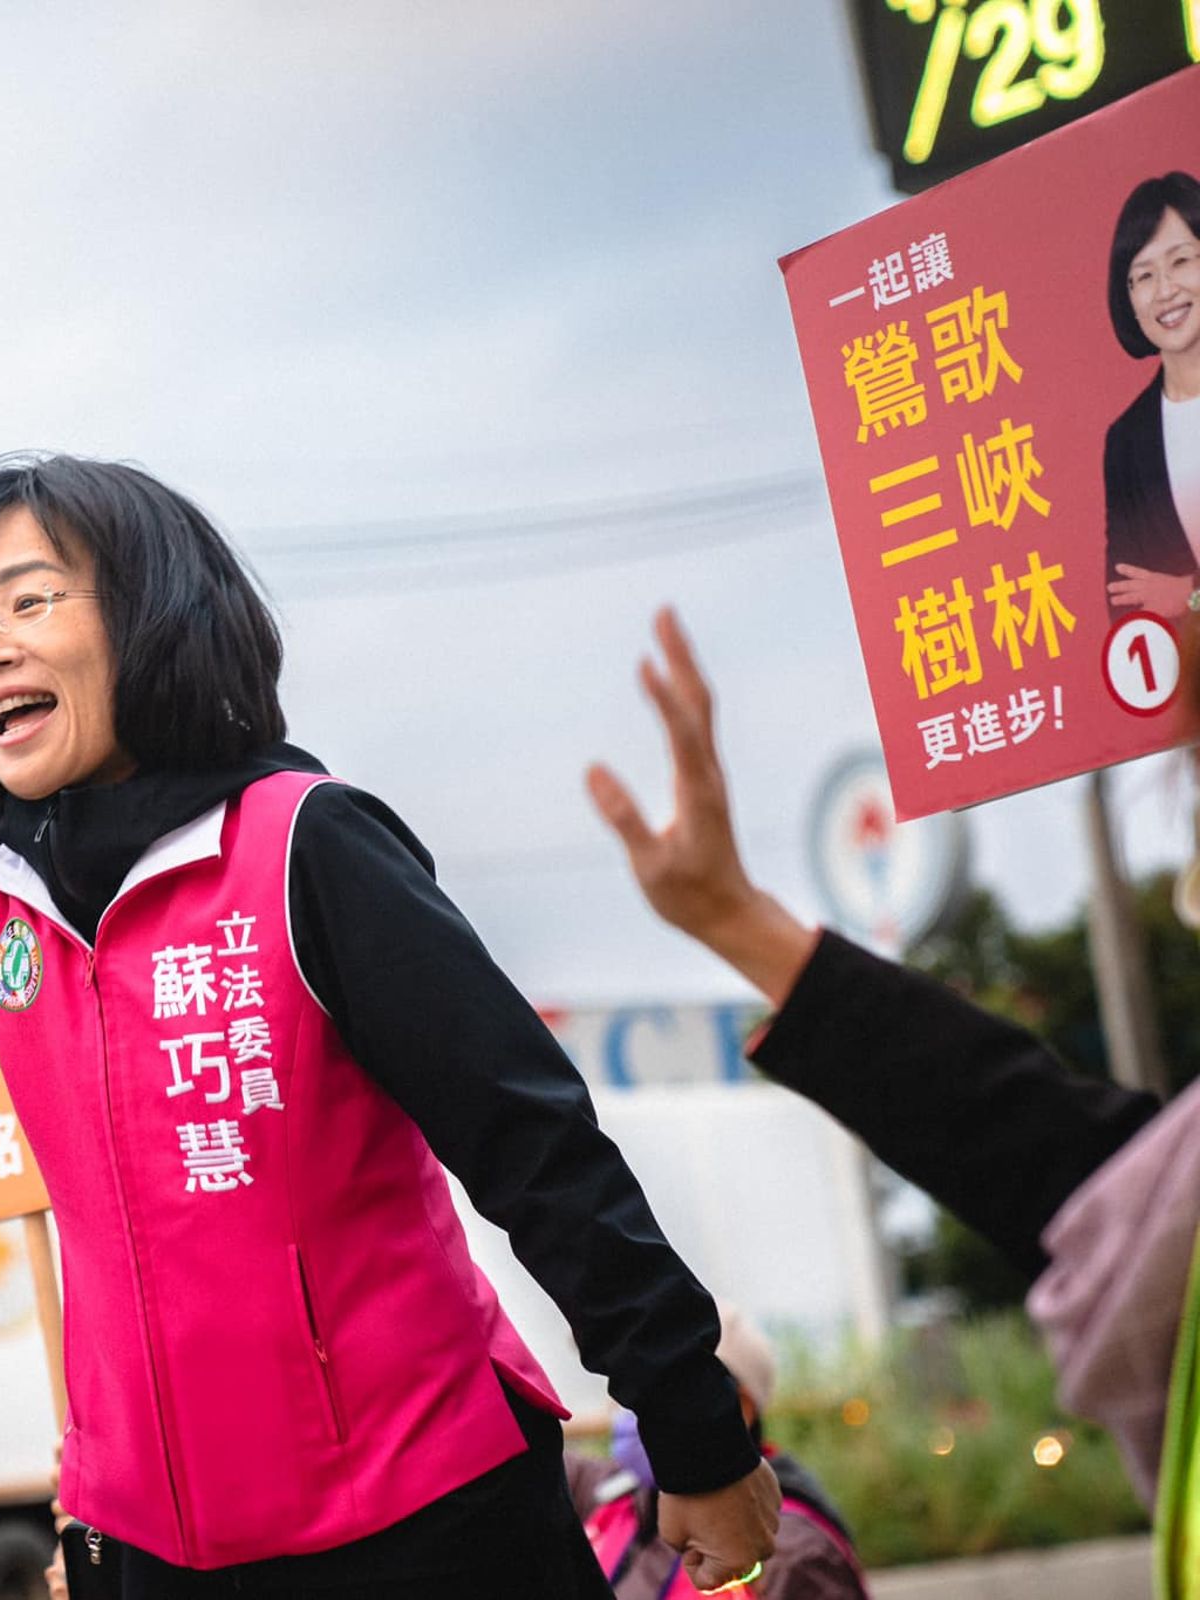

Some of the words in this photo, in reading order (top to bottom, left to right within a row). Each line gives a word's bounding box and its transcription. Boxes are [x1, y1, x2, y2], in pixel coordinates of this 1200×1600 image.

[886, 0, 1105, 164] /29
[828, 232, 954, 311] 一起讓
[841, 285, 1023, 444] 鶯歌
[869, 418, 1051, 568] 三峽
[894, 551, 1077, 700] 樹林
[1128, 634, 1157, 693] 1
[916, 685, 1064, 770] 更進步!
[151, 943, 254, 1193] 蘇巧慧
[216, 910, 285, 1115] 立法委員
